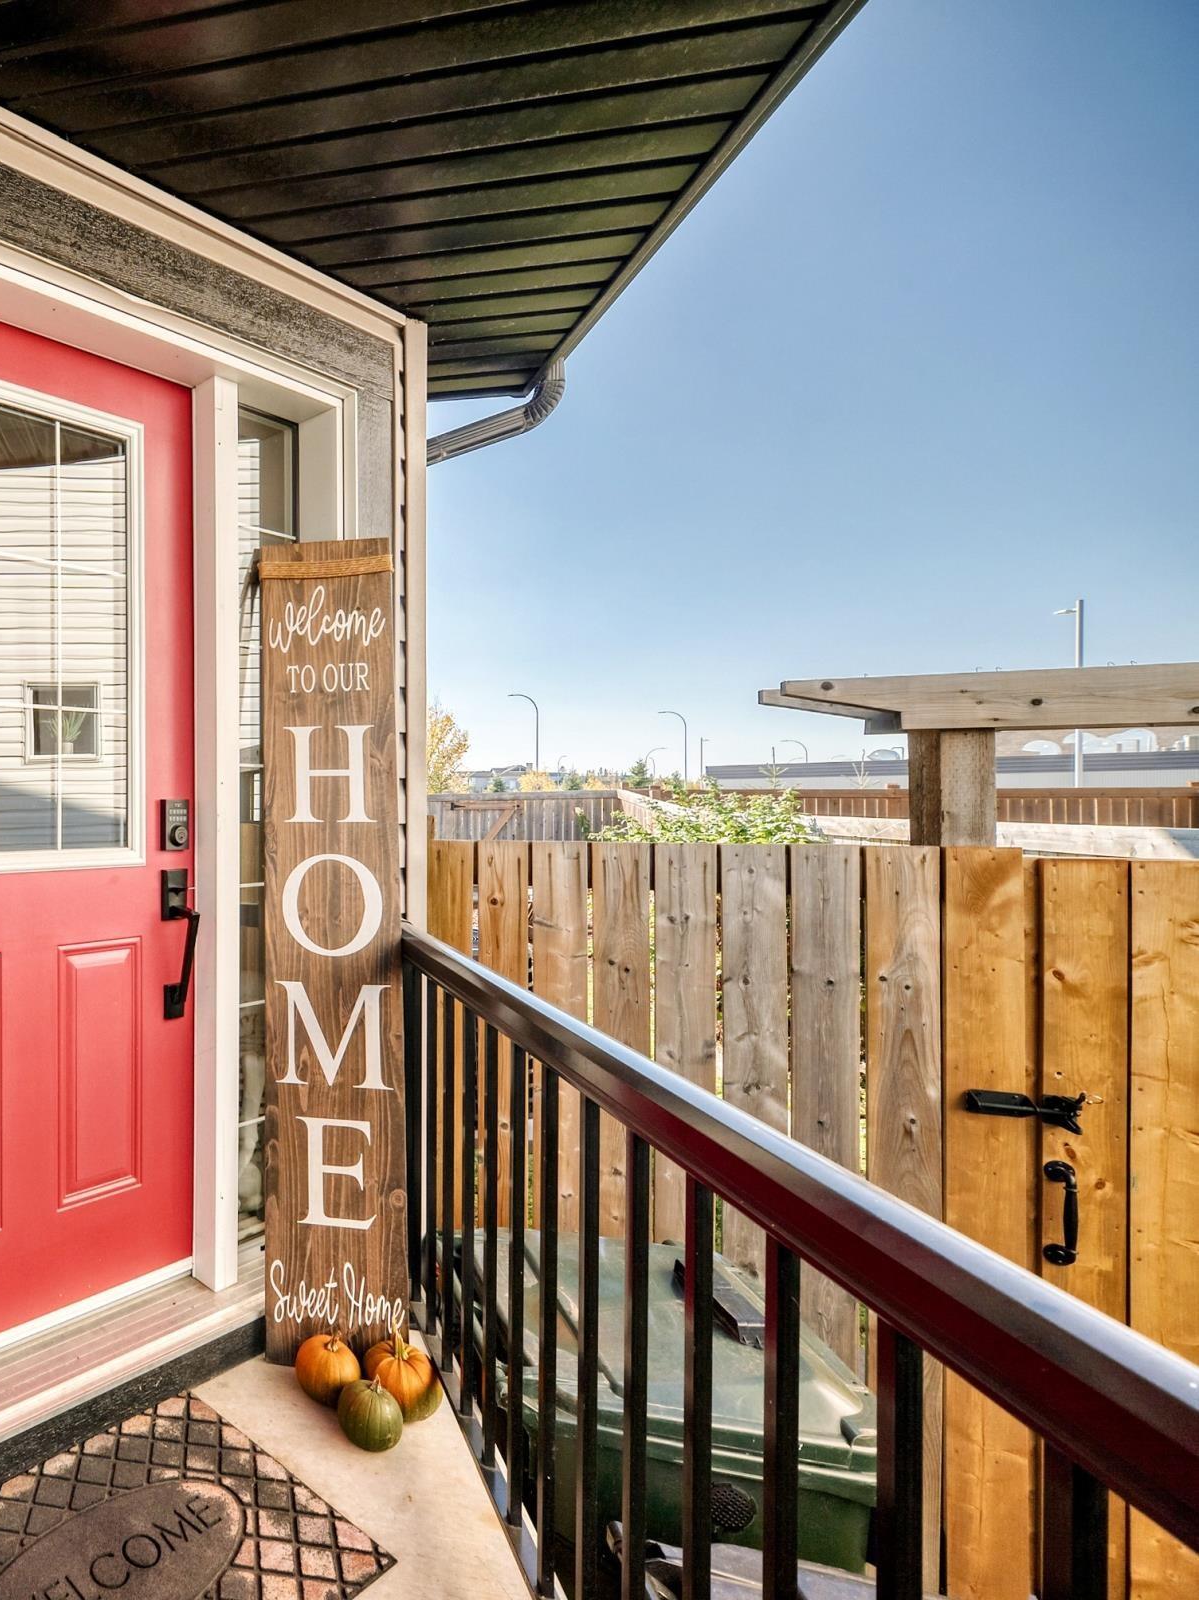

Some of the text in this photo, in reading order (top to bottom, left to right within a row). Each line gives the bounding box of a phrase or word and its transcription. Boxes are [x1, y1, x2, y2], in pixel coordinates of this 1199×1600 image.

[286, 662, 370, 693] TO OUR
[275, 724, 394, 1230] HOME
[269, 1259, 339, 1325] Sweet
[31, 1495, 222, 1600] ELCOME
